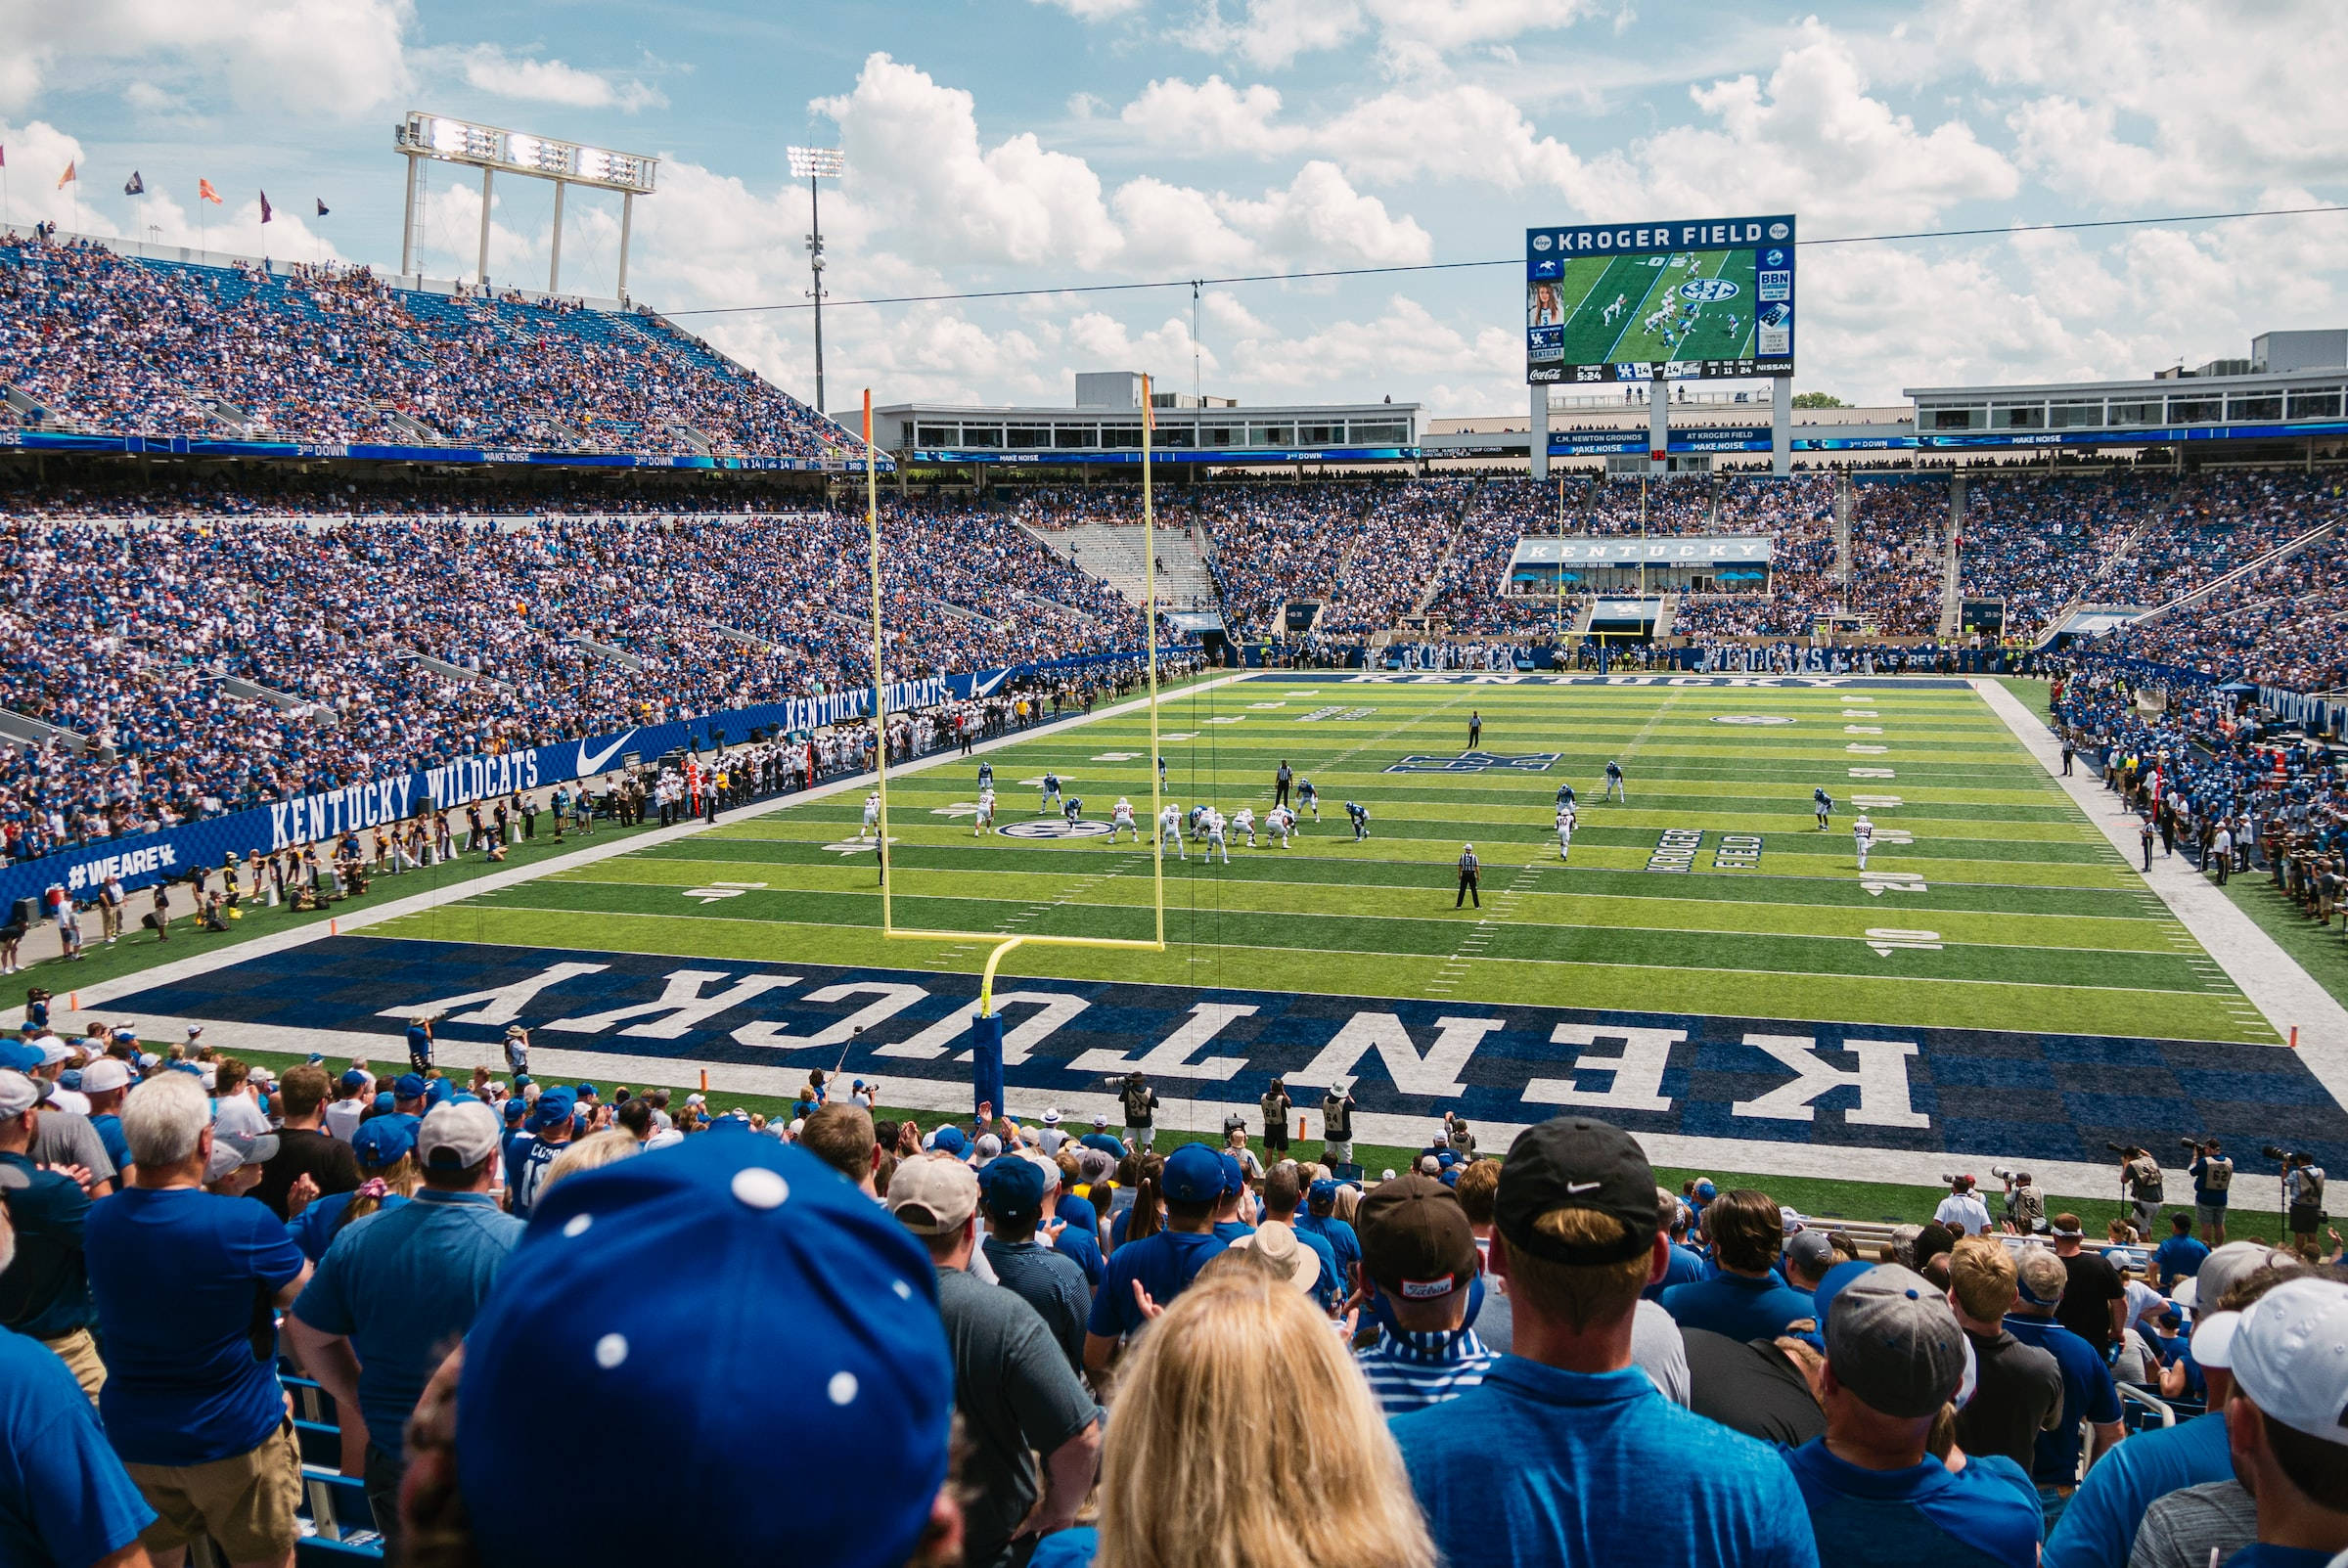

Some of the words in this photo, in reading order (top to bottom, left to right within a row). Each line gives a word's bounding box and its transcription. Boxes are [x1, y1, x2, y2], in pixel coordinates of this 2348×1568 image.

[1558, 229, 1670, 250] KROGER
[1683, 224, 1762, 245] FIELD
[1761, 273, 1788, 284] BBN
[1577, 372, 1602, 381] 5:24
[315, 444, 348, 457] DOWN
[1596, 444, 1622, 453] NOISE
[1717, 441, 1744, 450] NOISE
[483, 452, 506, 462] MAKE
[506, 452, 530, 462] NOISE
[649, 456, 673, 466] DOWN
[750, 459, 761, 469] 14
[780, 460, 790, 470] 14
[848, 462, 861, 470] 3RD
[1528, 545, 1758, 558] KENTUCKY
[1341, 675, 1853, 687] KENTUCKY
[786, 688, 869, 732] KENTUCKY
[271, 774, 412, 850] KENTUCKY
[426, 748, 538, 810] WILDCATS
[1168, 815, 1174, 825] 6
[1558, 817, 1568, 826] 10
[1645, 829, 1704, 873] KROGER
[1712, 835, 1763, 869] FIELD
[375, 962, 1931, 1129] KENTUCKY
[1326, 1112, 1338, 1124] 64
[2213, 1170, 2228, 1183] 62
